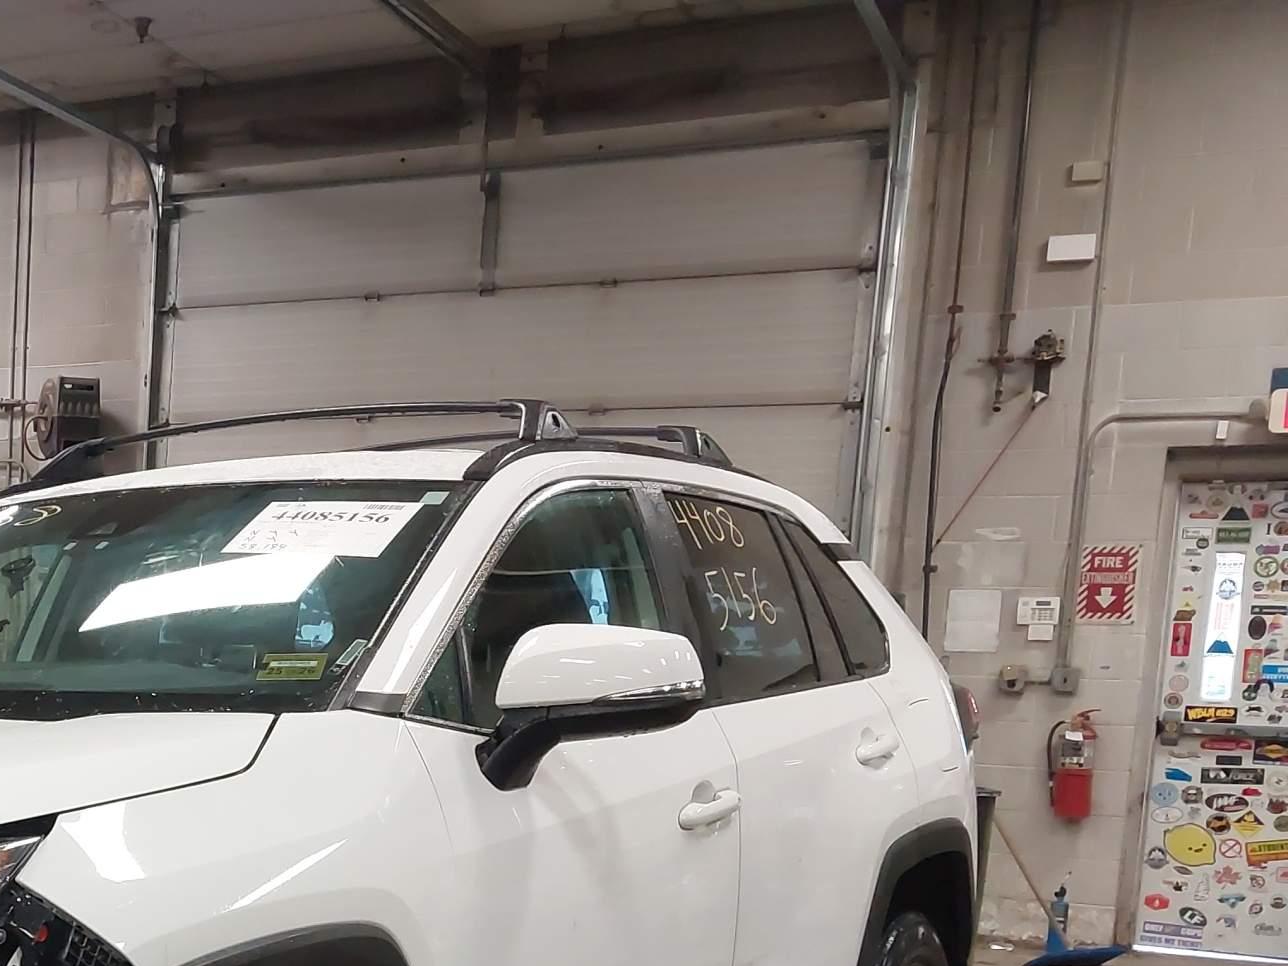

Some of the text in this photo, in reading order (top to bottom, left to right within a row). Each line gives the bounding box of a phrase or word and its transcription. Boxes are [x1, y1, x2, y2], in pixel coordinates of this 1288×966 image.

[272, 511, 392, 524] 44085156
[667, 499, 745, 550] 4408
[1094, 556, 1124, 569] FIRE
[703, 567, 777, 632] 5156
